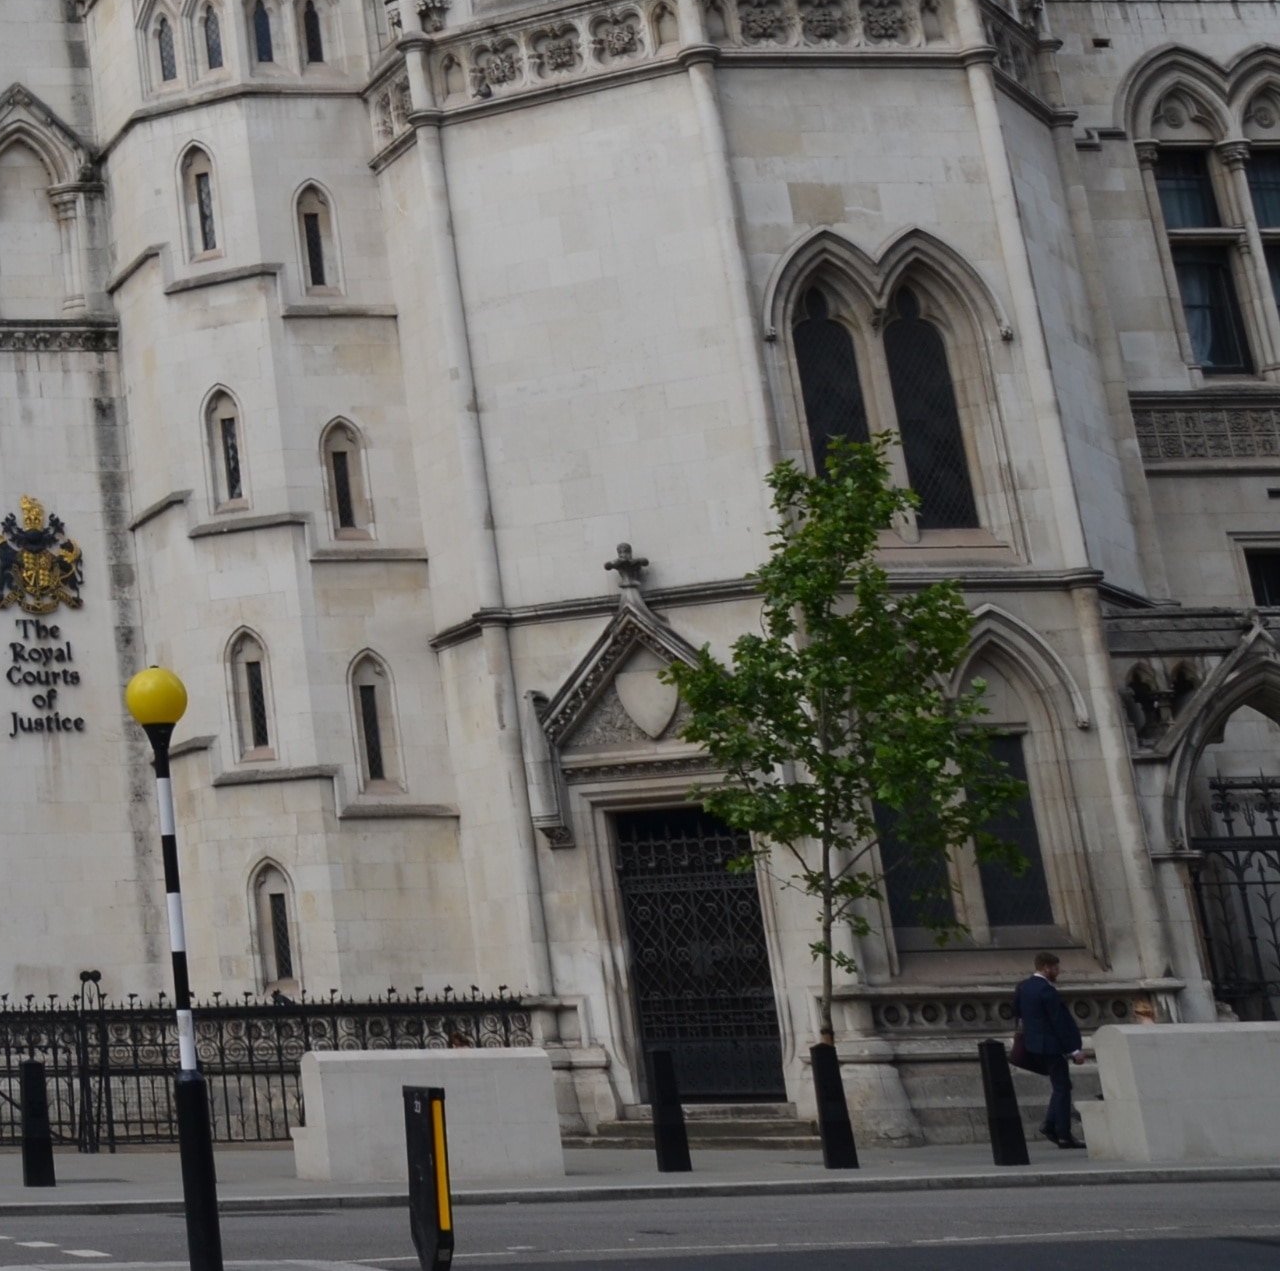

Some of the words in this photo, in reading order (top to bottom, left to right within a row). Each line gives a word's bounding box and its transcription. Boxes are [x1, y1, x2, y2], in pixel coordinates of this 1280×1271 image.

[15, 619, 61, 639] The
[9, 641, 73, 666] Royal
[6, 665, 80, 686] Courts
[32, 688, 58, 709] of
[9, 712, 85, 737] Justice
